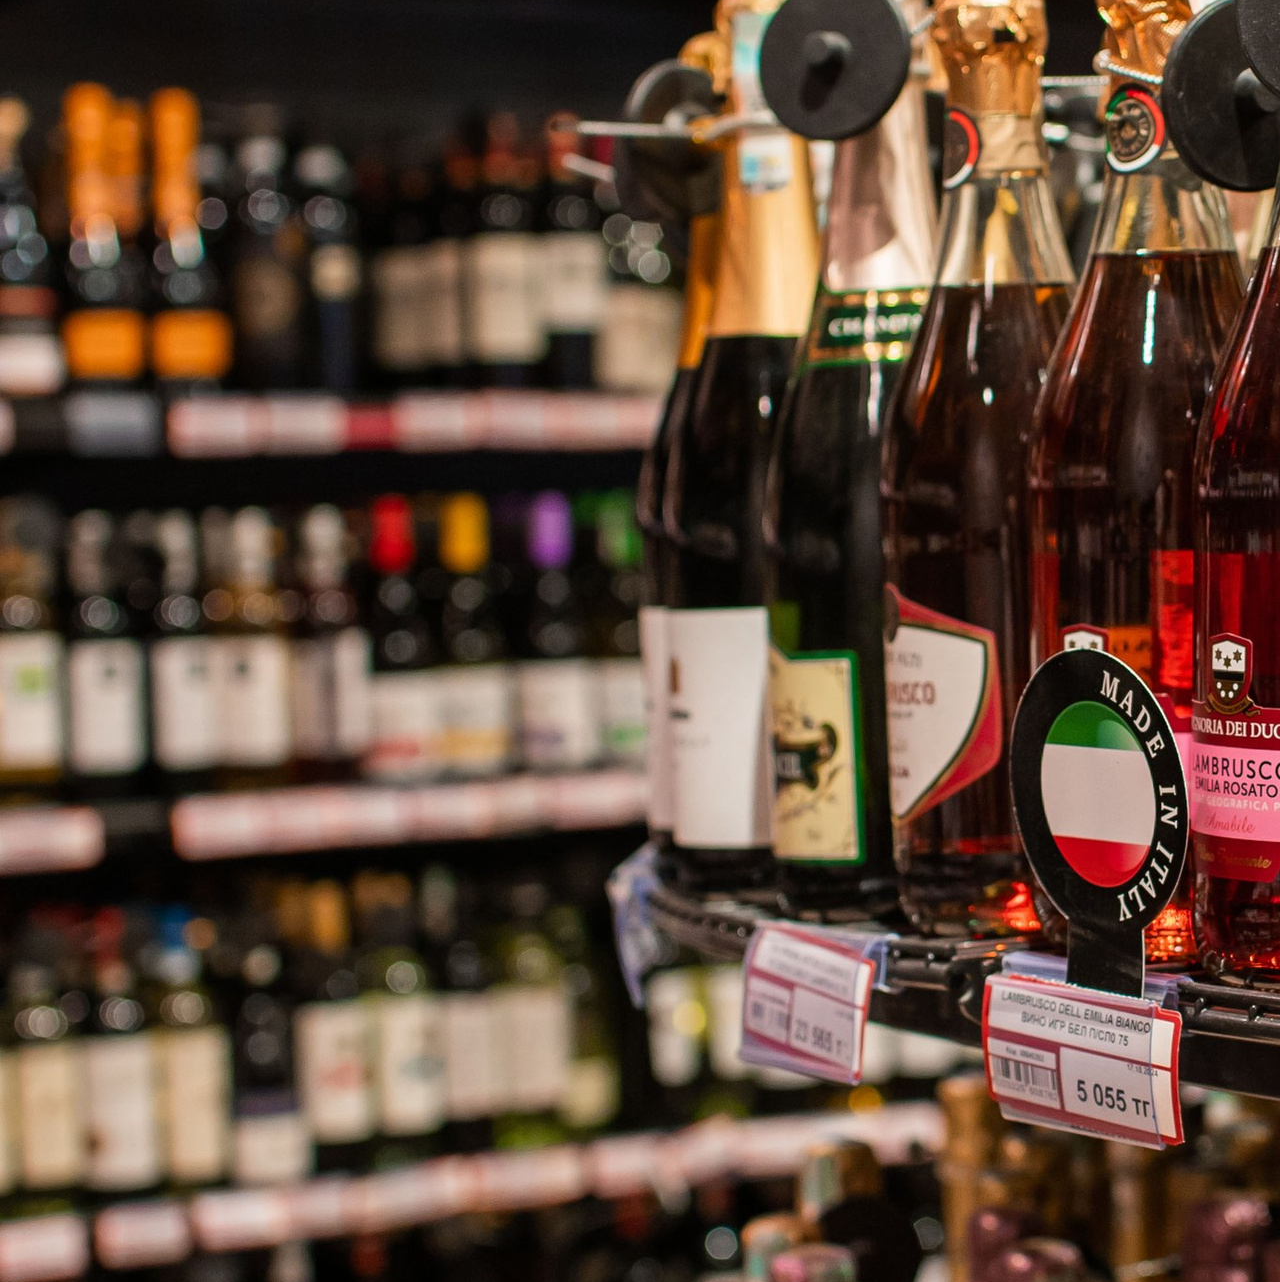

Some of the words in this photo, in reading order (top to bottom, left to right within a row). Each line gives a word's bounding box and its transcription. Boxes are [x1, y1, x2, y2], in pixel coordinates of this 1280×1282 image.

[1100, 670, 1165, 758] MADE
[1225, 720, 1248, 737] DEI
[1158, 784, 1178, 829] IN
[1223, 780, 1279, 799] ROSATO
[1204, 812, 1256, 834] Amabile
[1117, 841, 1174, 922] ITALY
[1001, 990, 1057, 1013] LAMBRUSCO
[1058, 1003, 1082, 1019] DELL
[1083, 1008, 1114, 1025] EMILIA
[1115, 1015, 1151, 1033] BIANCO
[1021, 1011, 1046, 1028] ВИНО
[1048, 1018, 1066, 1032] ИГР
[1067, 1023, 1087, 1038] БЕЛ
[1077, 1078, 1088, 1103] 5
[1093, 1082, 1127, 1113] 055
